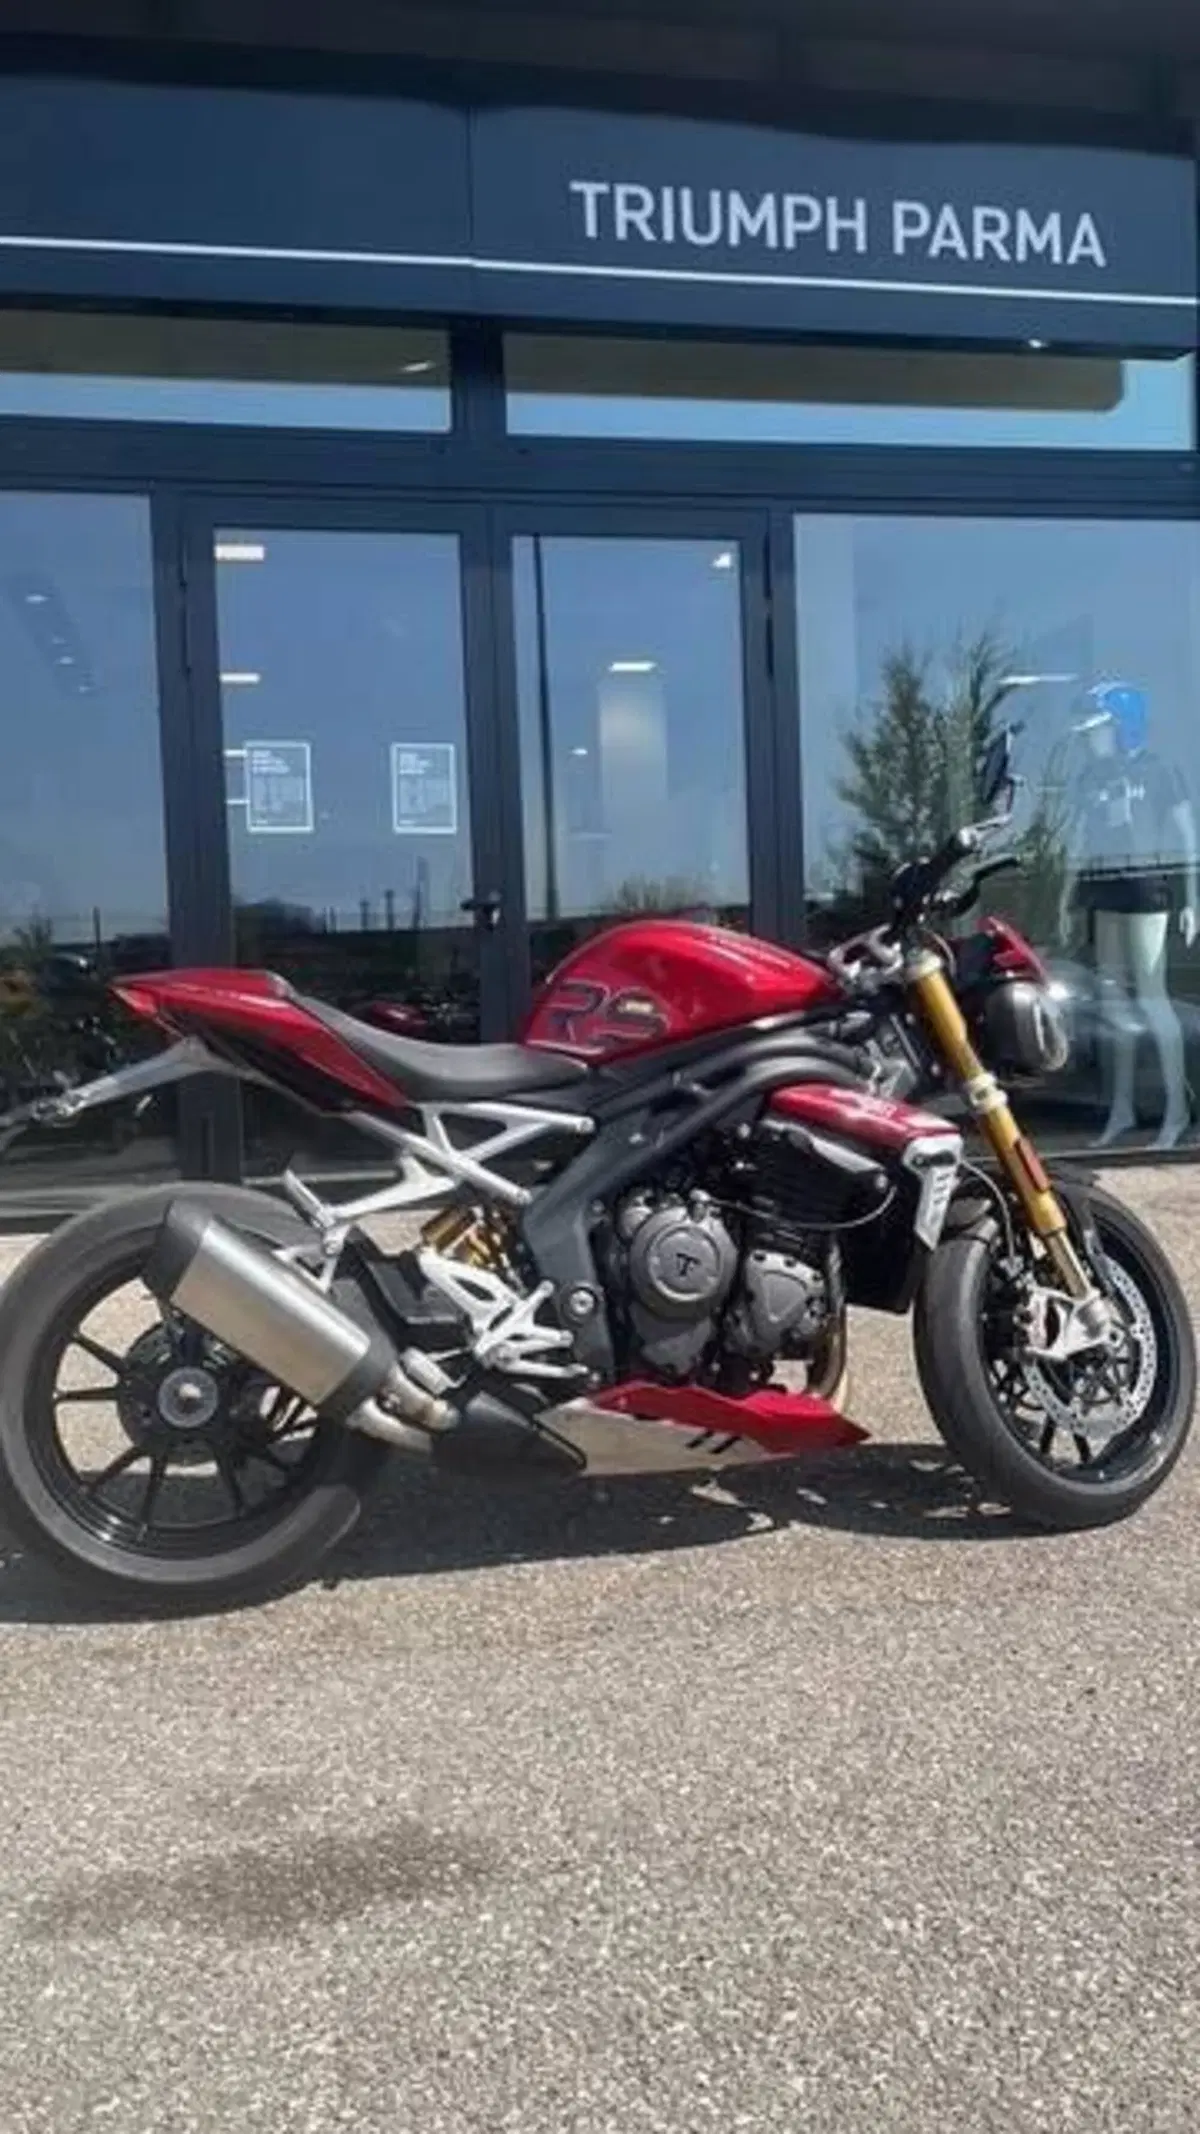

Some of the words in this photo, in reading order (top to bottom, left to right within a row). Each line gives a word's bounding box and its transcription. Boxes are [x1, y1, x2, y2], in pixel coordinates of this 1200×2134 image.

[569, 180, 868, 253] TRIUMPH
[893, 200, 1107, 269] PARMA
[541, 978, 672, 1050] RS
